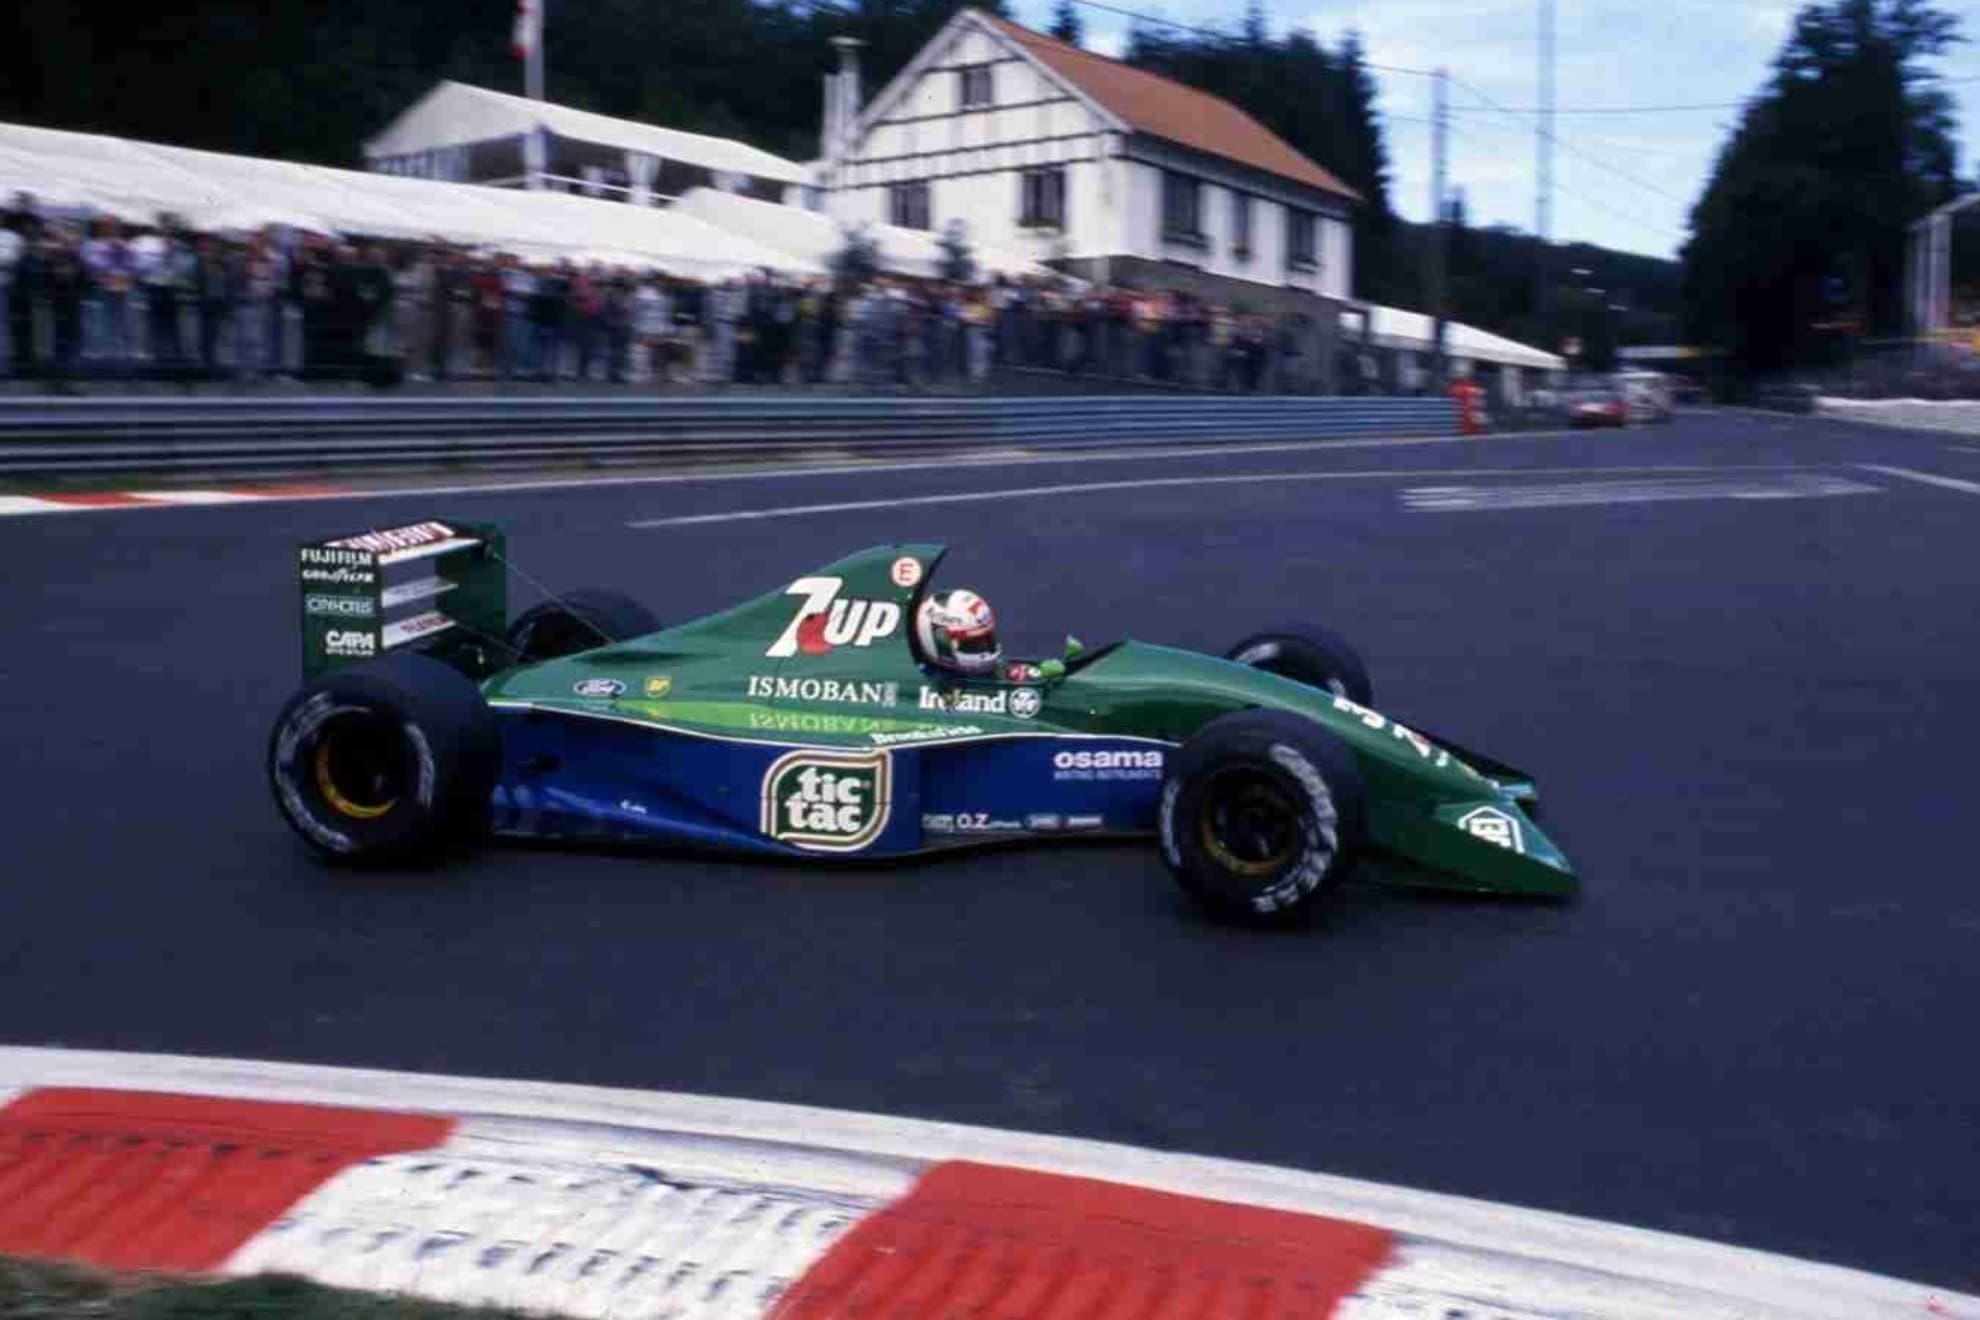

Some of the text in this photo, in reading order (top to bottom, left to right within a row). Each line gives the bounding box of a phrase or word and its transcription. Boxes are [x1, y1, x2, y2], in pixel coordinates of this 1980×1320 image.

[301, 548, 373, 565] FUJIFILM
[900, 563, 913, 581] E
[748, 676, 882, 703] ISMOBAN
[1054, 751, 1163, 769] osama
[797, 767, 862, 803] tic
[786, 793, 862, 832] tac
